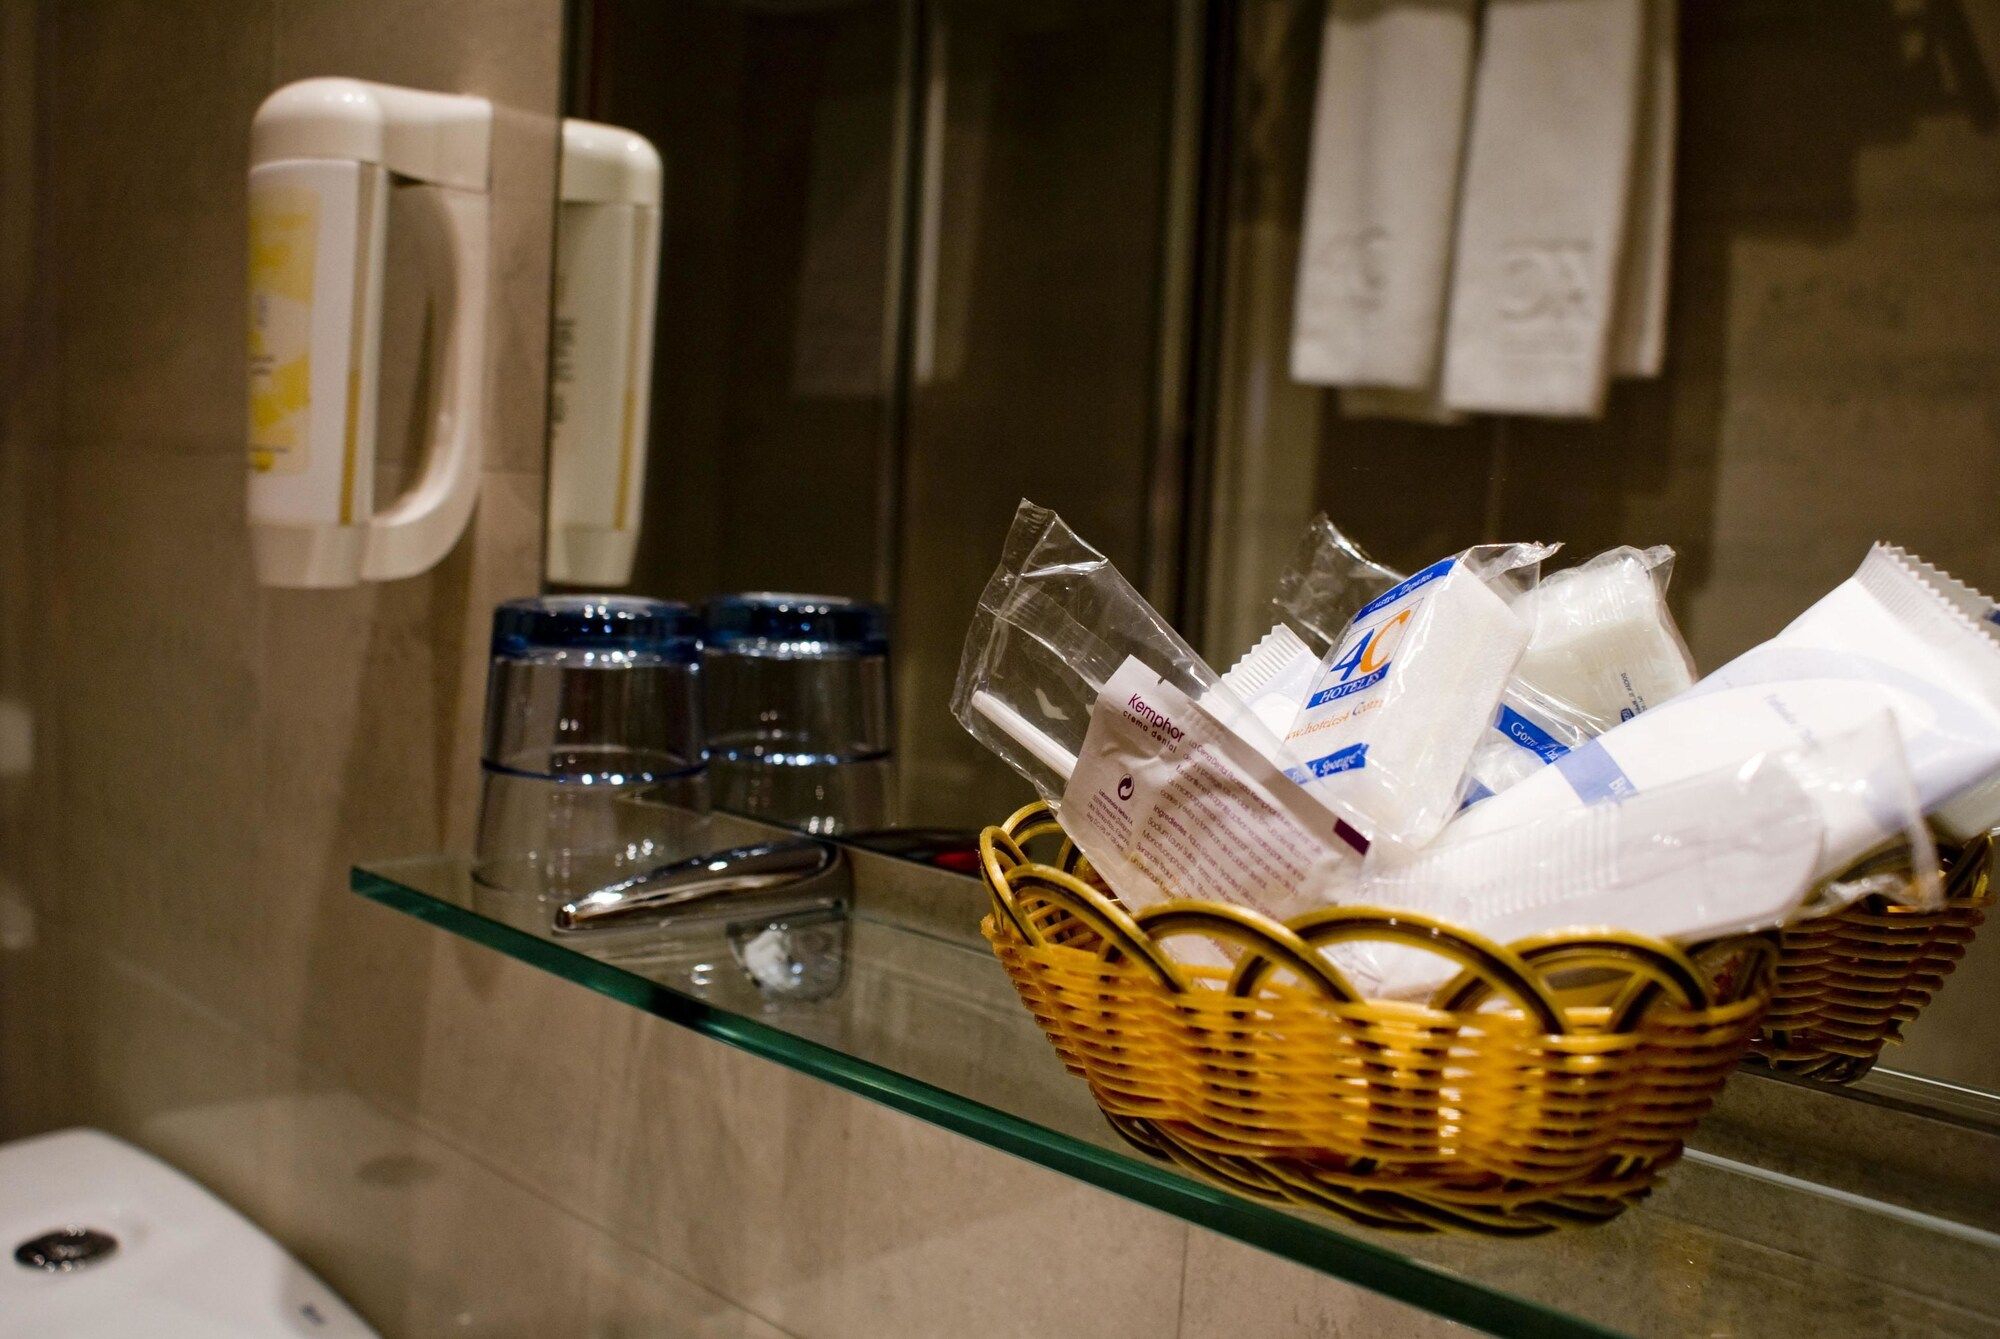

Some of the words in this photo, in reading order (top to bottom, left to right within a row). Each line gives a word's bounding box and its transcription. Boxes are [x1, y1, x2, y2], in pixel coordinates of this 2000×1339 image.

[1330, 609, 1411, 681] 4C
[1319, 671, 1380, 704] HOTELES
[1122, 710, 1148, 735] crema
[1151, 729, 1178, 754] dental
[1128, 693, 1186, 742] Kemphor
